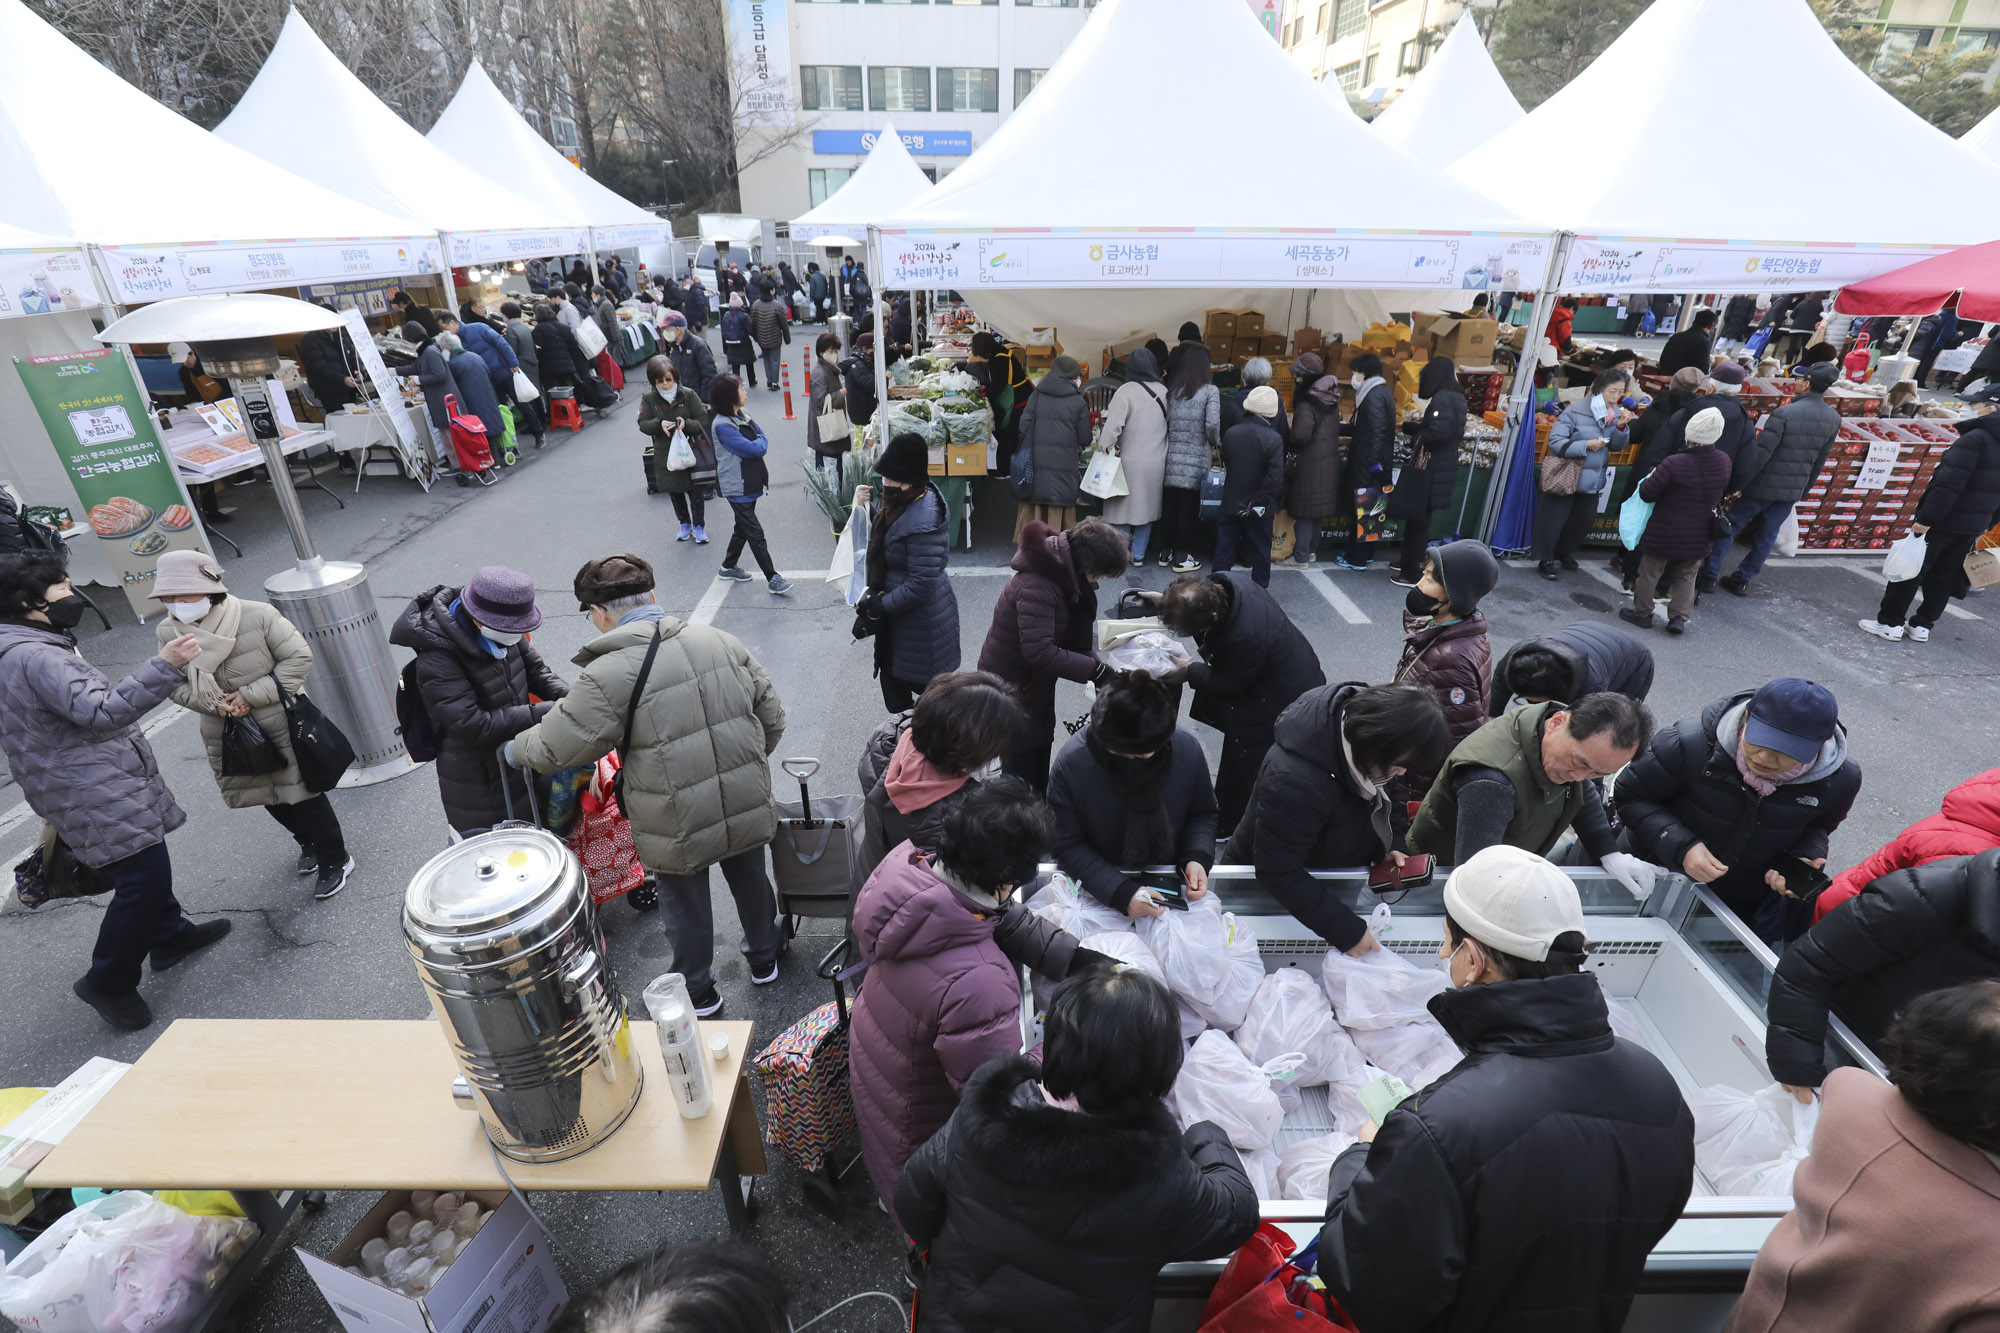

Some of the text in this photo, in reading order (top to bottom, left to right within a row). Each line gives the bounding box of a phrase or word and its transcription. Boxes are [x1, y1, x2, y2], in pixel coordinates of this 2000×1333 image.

[751, 4, 768, 80] 등급 달성
[914, 243, 936, 251] 2024
[1106, 244, 1351, 262] 금사농협 세곡동농가
[1600, 250, 1620, 258] 2024
[130, 257, 148, 265] 2024
[248, 252, 286, 268] 청도양봉원
[340, 248, 370, 261] 정담두부집
[898, 252, 953, 265] 설맞이 강남구
[1582, 258, 1632, 270] 설맞이 강남구
[1762, 257, 1822, 274] 북단양농협
[122, 266, 163, 280] 설맞이 강남구
[894, 266, 959, 281] 직거래장터
[1572, 271, 1632, 286] 직거래장터
[123, 278, 173, 295] 직거래장터
[58, 399, 81, 410] 한국의
[92, 396, 113, 404] 세계의
[90, 416, 113, 427] 한국
[84, 423, 126, 437] 농협김치
[70, 441, 154, 464] 김치 종주국의 대표주자
